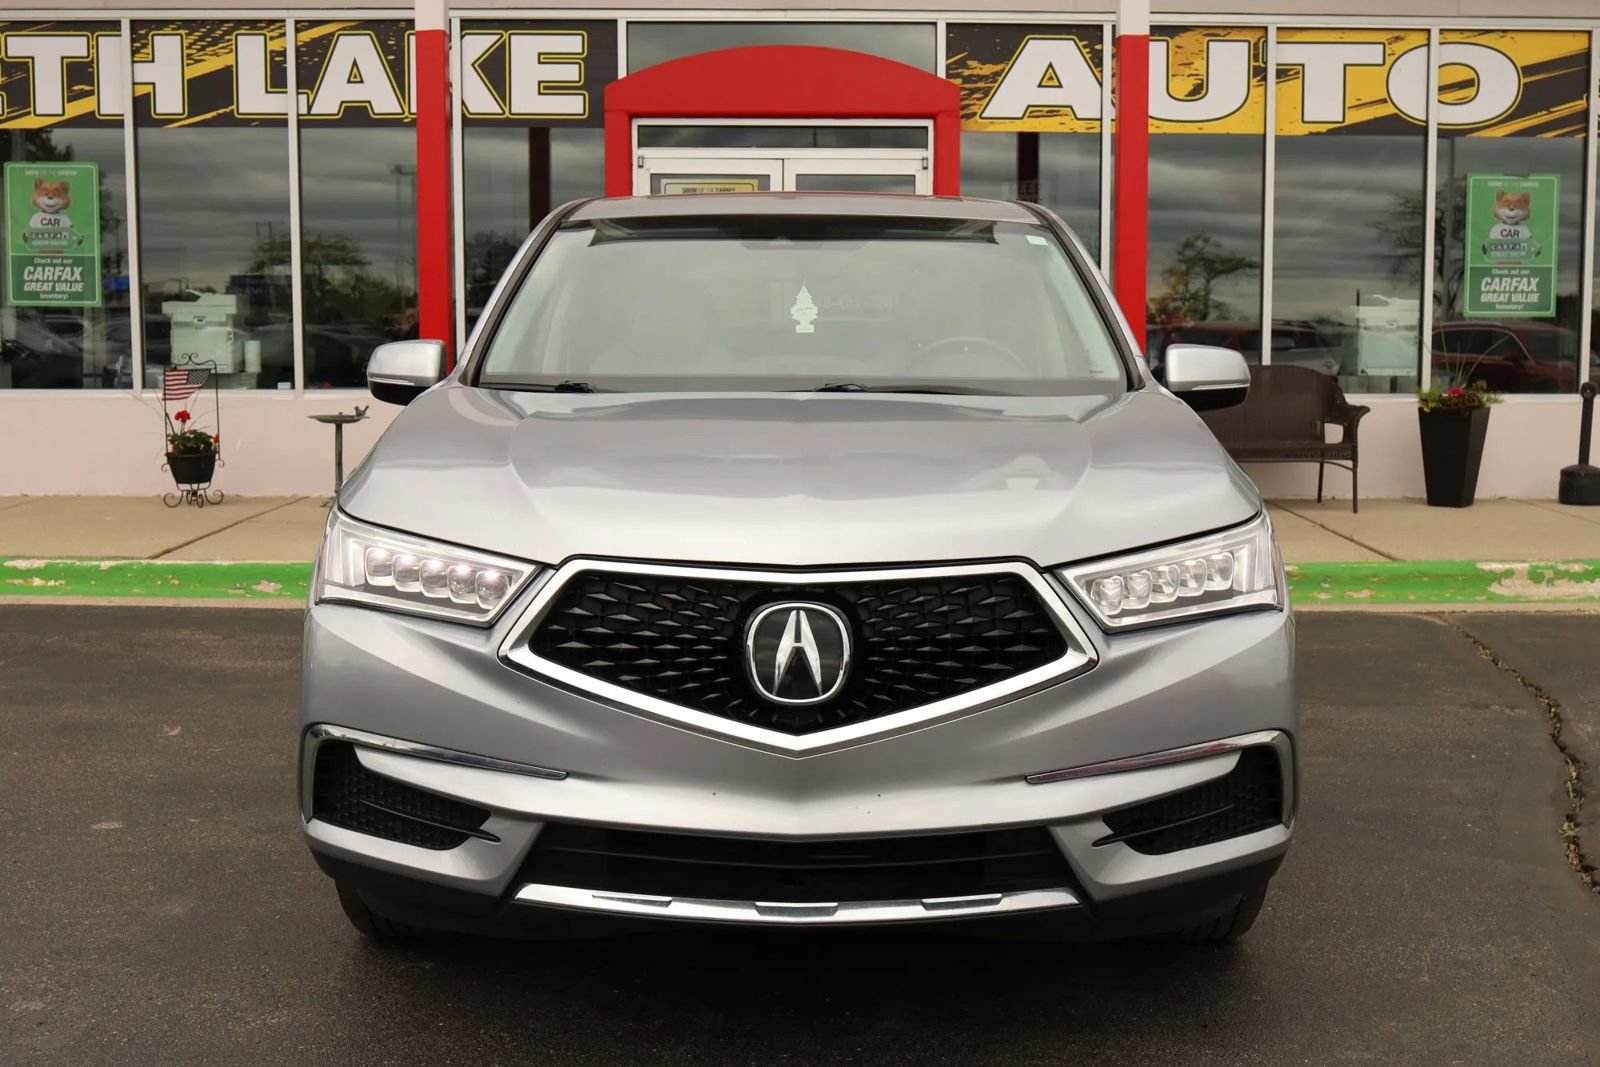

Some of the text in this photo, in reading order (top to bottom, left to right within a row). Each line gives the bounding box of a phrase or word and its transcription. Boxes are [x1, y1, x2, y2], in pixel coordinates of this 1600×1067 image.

[0, 31, 1523, 128] TH LAKE AUTO
[41, 217, 61, 226] CAR
[1500, 228, 1520, 238] CAR
[23, 265, 83, 281] CARFAX
[24, 282, 85, 292] GREAT VALUE
[1480, 277, 1540, 292] CARFAX
[1480, 293, 1541, 303] GREAT VALUE
